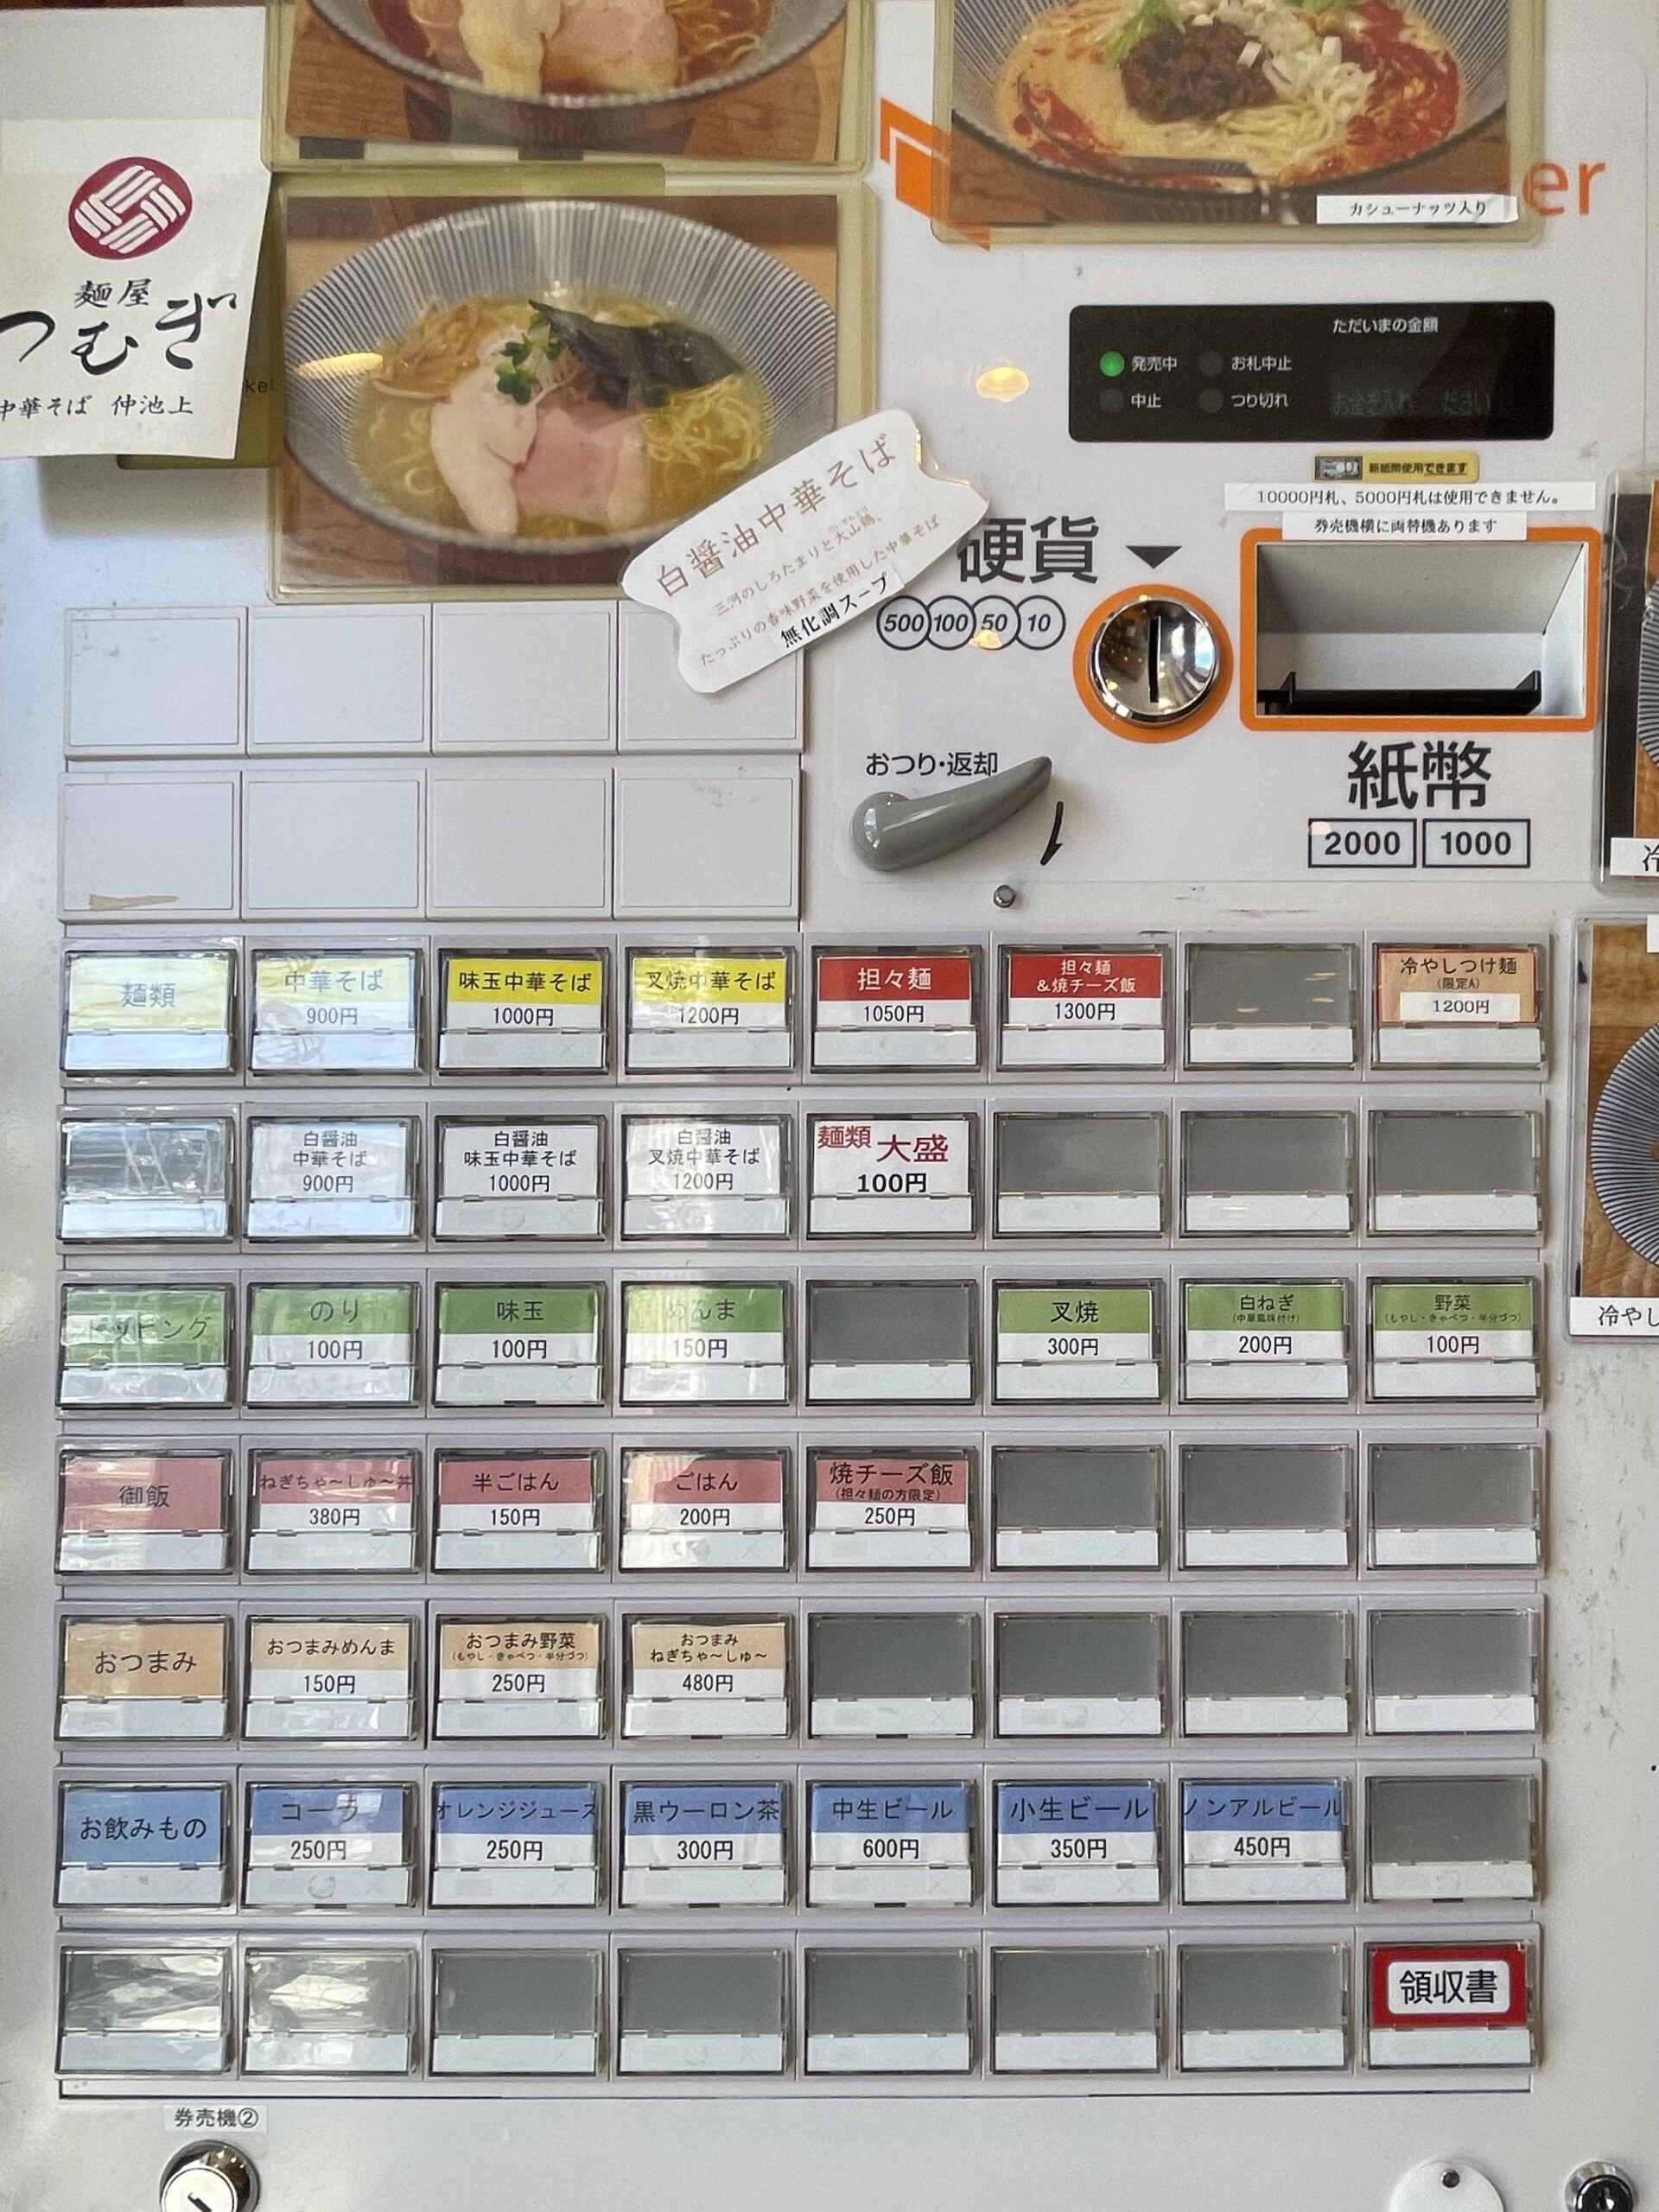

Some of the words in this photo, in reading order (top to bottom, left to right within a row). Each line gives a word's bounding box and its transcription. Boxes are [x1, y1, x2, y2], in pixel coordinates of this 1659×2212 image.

[1350, 200, 1487, 218] カシューナッツ入り
[74, 278, 151, 308] 麺屋
[0, 293, 237, 375] つむぎ
[1332, 318, 1439, 334] ただいまの金額
[1132, 356, 1178, 371] 発売中
[1231, 356, 1292, 372] お札中止
[0, 395, 92, 422] 中華そば
[111, 395, 194, 416] 仲池上
[1132, 393, 1161, 409] 中止
[1231, 393, 1288, 409] つり切れ
[1258, 491, 1560, 505] 10000円札、5000円札は使用できません。
[656, 433, 897, 597] 白醤油中華そば
[1314, 519, 1497, 534] 券売機横に両替機あります
[958, 515, 1097, 584] 硬貨
[780, 572, 888, 648] 無化調スープ
[883, 613, 925, 632] 500
[932, 613, 969, 632] 100
[981, 613, 1008, 632] 50
[1027, 613, 1052, 632] 10
[865, 752, 999, 779] おつり・返却
[1347, 741, 1492, 810] 紙幣
[1324, 830, 1401, 857] 2000
[1440, 830, 1511, 857] 1000
[1061, 960, 1110, 975] 担々麺
[1401, 957, 1516, 975] 冷やしつけ麺
[285, 969, 384, 993] 中華そば
[459, 971, 592, 992] 味玉中華そば
[647, 970, 776, 991] 叉焼中華そば
[858, 968, 931, 990] 担々麺
[1037, 978, 1135, 994] &焼チーズ飯
[121, 982, 175, 1007] 麺類
[307, 1008, 358, 1025] 900円
[679, 1007, 739, 1025] 1200円
[864, 1006, 925, 1023] 1050円
[1055, 1003, 1116, 1020] 1300円
[1433, 1000, 1490, 1014] 1200円
[493, 1008, 554, 1026] 1000円
[303, 1131, 358, 1147] 白醤油
[495, 1131, 548, 1147] 白醤油
[678, 1129, 731, 1146] 白醤油
[817, 1126, 871, 1148] 麺類
[877, 1134, 949, 1162] 大盛
[293, 1151, 366, 1167] 中華そば
[464, 1150, 576, 1167] 味玉中華そば
[649, 1149, 760, 1165] 叉焼中華そば
[302, 1175, 353, 1192] 900円
[489, 1174, 550, 1192] 1000円
[673, 1173, 734, 1190] 1200円
[857, 1173, 926, 1193] 100円
[310, 1300, 359, 1324] のり
[497, 1300, 544, 1321] 味玉
[1051, 1300, 1099, 1324] 叉焼
[1240, 1295, 1294, 1311] 白ねぎ
[1434, 1294, 1471, 1312] 野菜
[1599, 1305, 1659, 1326] 冷やし
[308, 1340, 363, 1359] 100円
[493, 1339, 547, 1359] 100円
[673, 1338, 728, 1358] 150円
[1048, 1338, 1098, 1356] 300円
[1239, 1336, 1292, 1355] 200円
[1427, 1335, 1479, 1354] 100円
[473, 1472, 559, 1492] 半ごはん
[677, 1472, 738, 1491] ごはん
[830, 1462, 953, 1485] 焼チーズ飯
[119, 1484, 170, 1508] 御飯
[309, 1508, 360, 1526] 380円
[492, 1509, 540, 1526] 150円
[680, 1509, 730, 1526] 200円
[864, 1508, 915, 1526] 250円
[267, 1638, 395, 1656] おつまみめんま
[467, 1632, 576, 1649] おつまみ野菜
[681, 1633, 738, 1646] おつまみ
[95, 1650, 197, 1674] おつまみ
[304, 1675, 355, 1694] 150円
[493, 1675, 545, 1693] 250円
[683, 1674, 734, 1692] 480円
[282, 1799, 358, 1823] コーラ
[436, 1801, 595, 1821] オレンジジュース
[633, 1799, 779, 1822] 黒ウーロン茶
[833, 1798, 953, 1821] 中生ビール
[1011, 1797, 1149, 1821] 小生ビール
[1185, 1796, 1342, 1818] ノンアルビール
[80, 1816, 207, 1840] お飲みもの
[291, 1840, 346, 1860] 250円
[486, 1840, 543, 1861] 250円
[677, 1840, 734, 1860] 300円
[864, 1839, 918, 1859] 600円
[1051, 1839, 1107, 1859] 350円
[1234, 1837, 1290, 1857] 450円
[1399, 1970, 1497, 2005] 領収書
[175, 2108, 258, 2127] 券売機②
